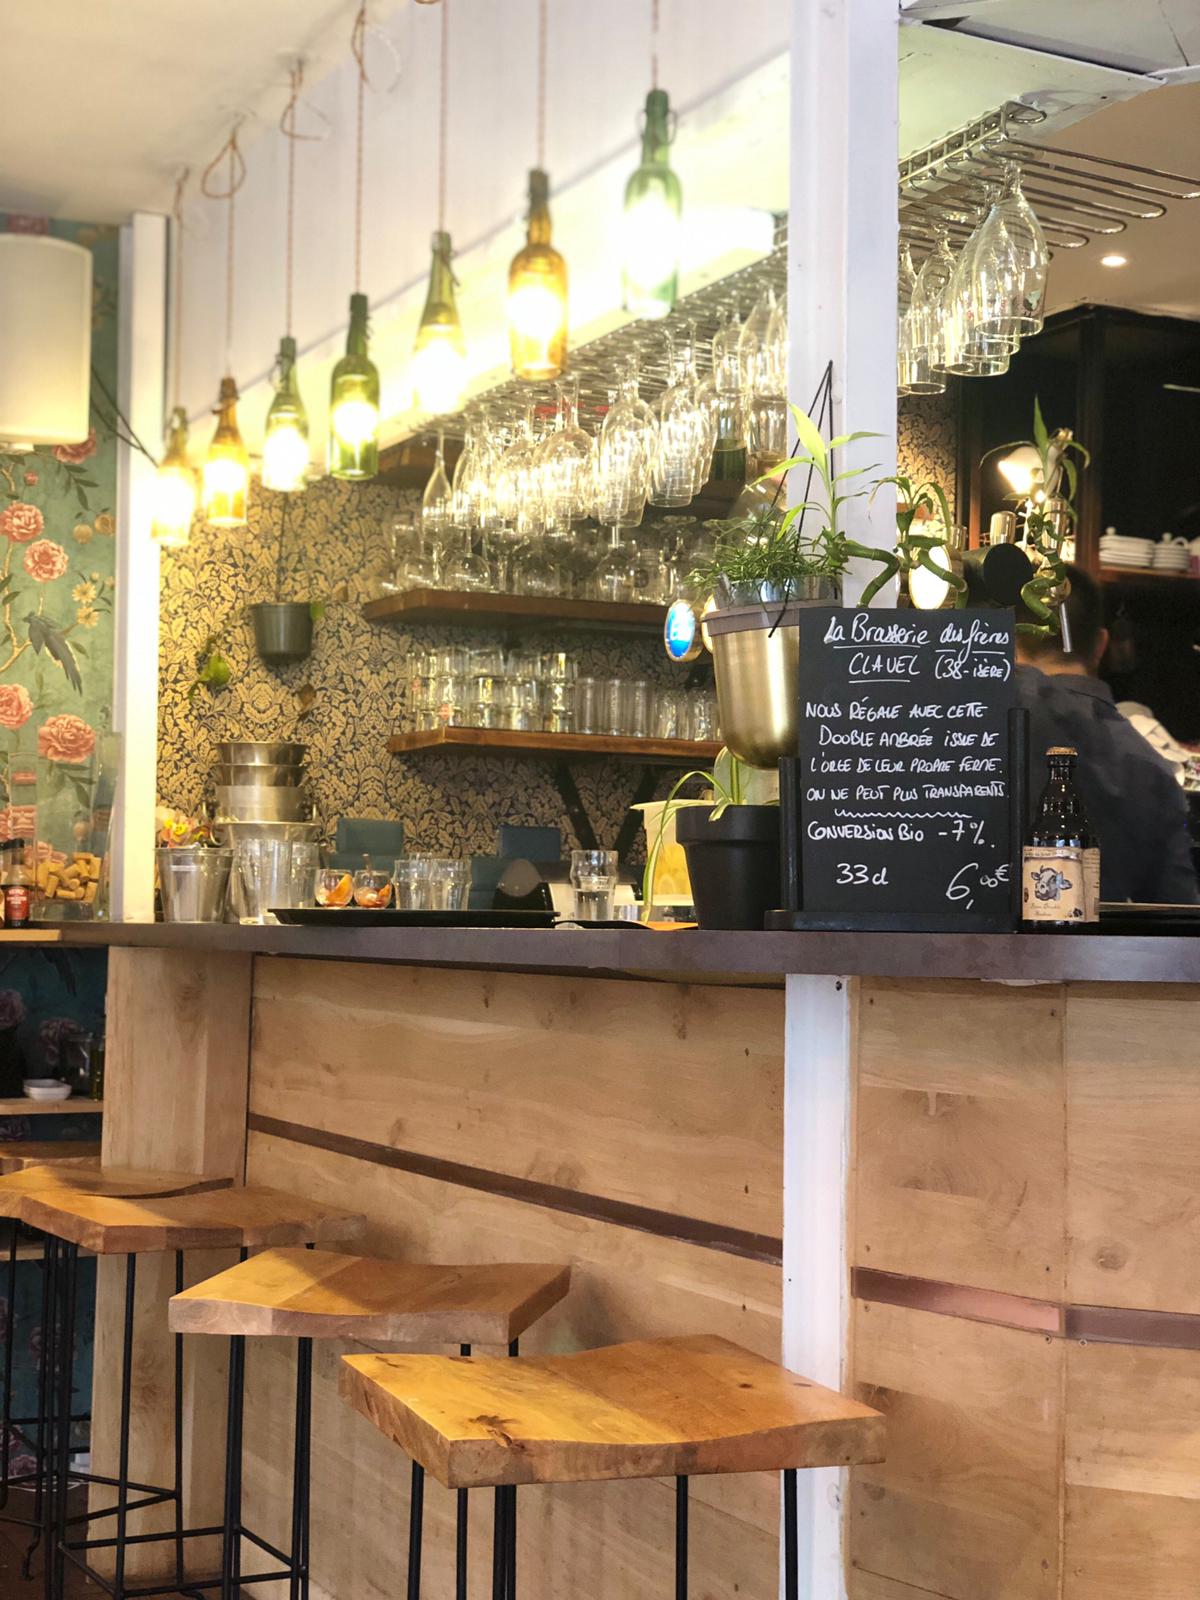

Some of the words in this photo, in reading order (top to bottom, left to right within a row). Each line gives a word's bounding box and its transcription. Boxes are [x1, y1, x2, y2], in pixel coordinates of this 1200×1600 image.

[823, 616, 846, 644] La
[851, 613, 930, 645] Brasserie
[940, 622, 963, 644] des
[958, 619, 1010, 664] frères
[849, 652, 921, 676] CLAVEL
[805, 702, 842, 718] NOUS
[849, 696, 903, 722] RÉGALE
[909, 703, 944, 719] AVEC
[947, 702, 988, 718] CETTE
[981, 731, 1000, 747] DE
[856, 757, 874, 773] DE
[875, 758, 906, 772] LEUR
[909, 757, 956, 773] PROPRE
[806, 788, 825, 801] ON
[831, 788, 849, 800] NE
[856, 785, 890, 800] PEUT
[893, 787, 918, 801] PLUS
